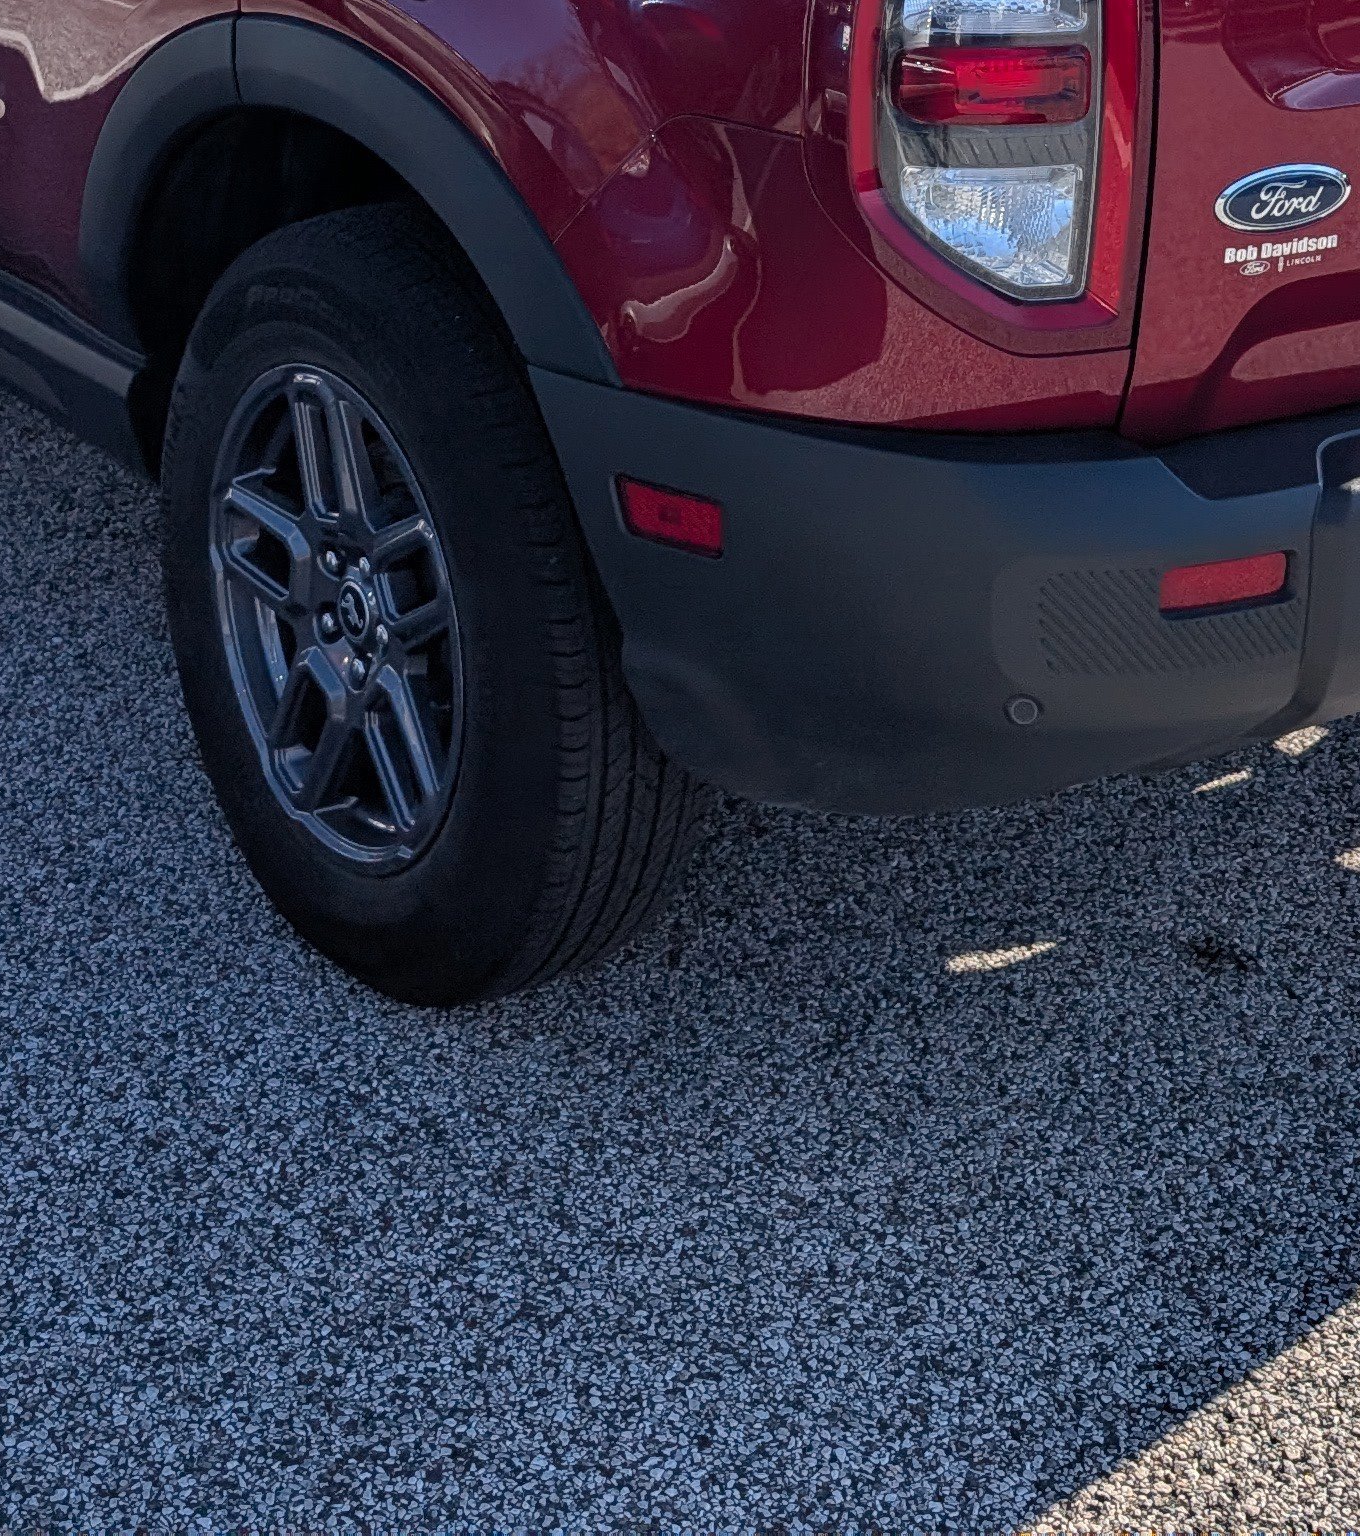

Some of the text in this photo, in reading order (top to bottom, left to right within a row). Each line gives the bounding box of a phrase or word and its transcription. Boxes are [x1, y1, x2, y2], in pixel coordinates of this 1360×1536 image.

[1250, 179, 1324, 220] Ford
[1224, 233, 1338, 264] Bob Davidson
[1242, 254, 1322, 274] Ford LINCOLN
